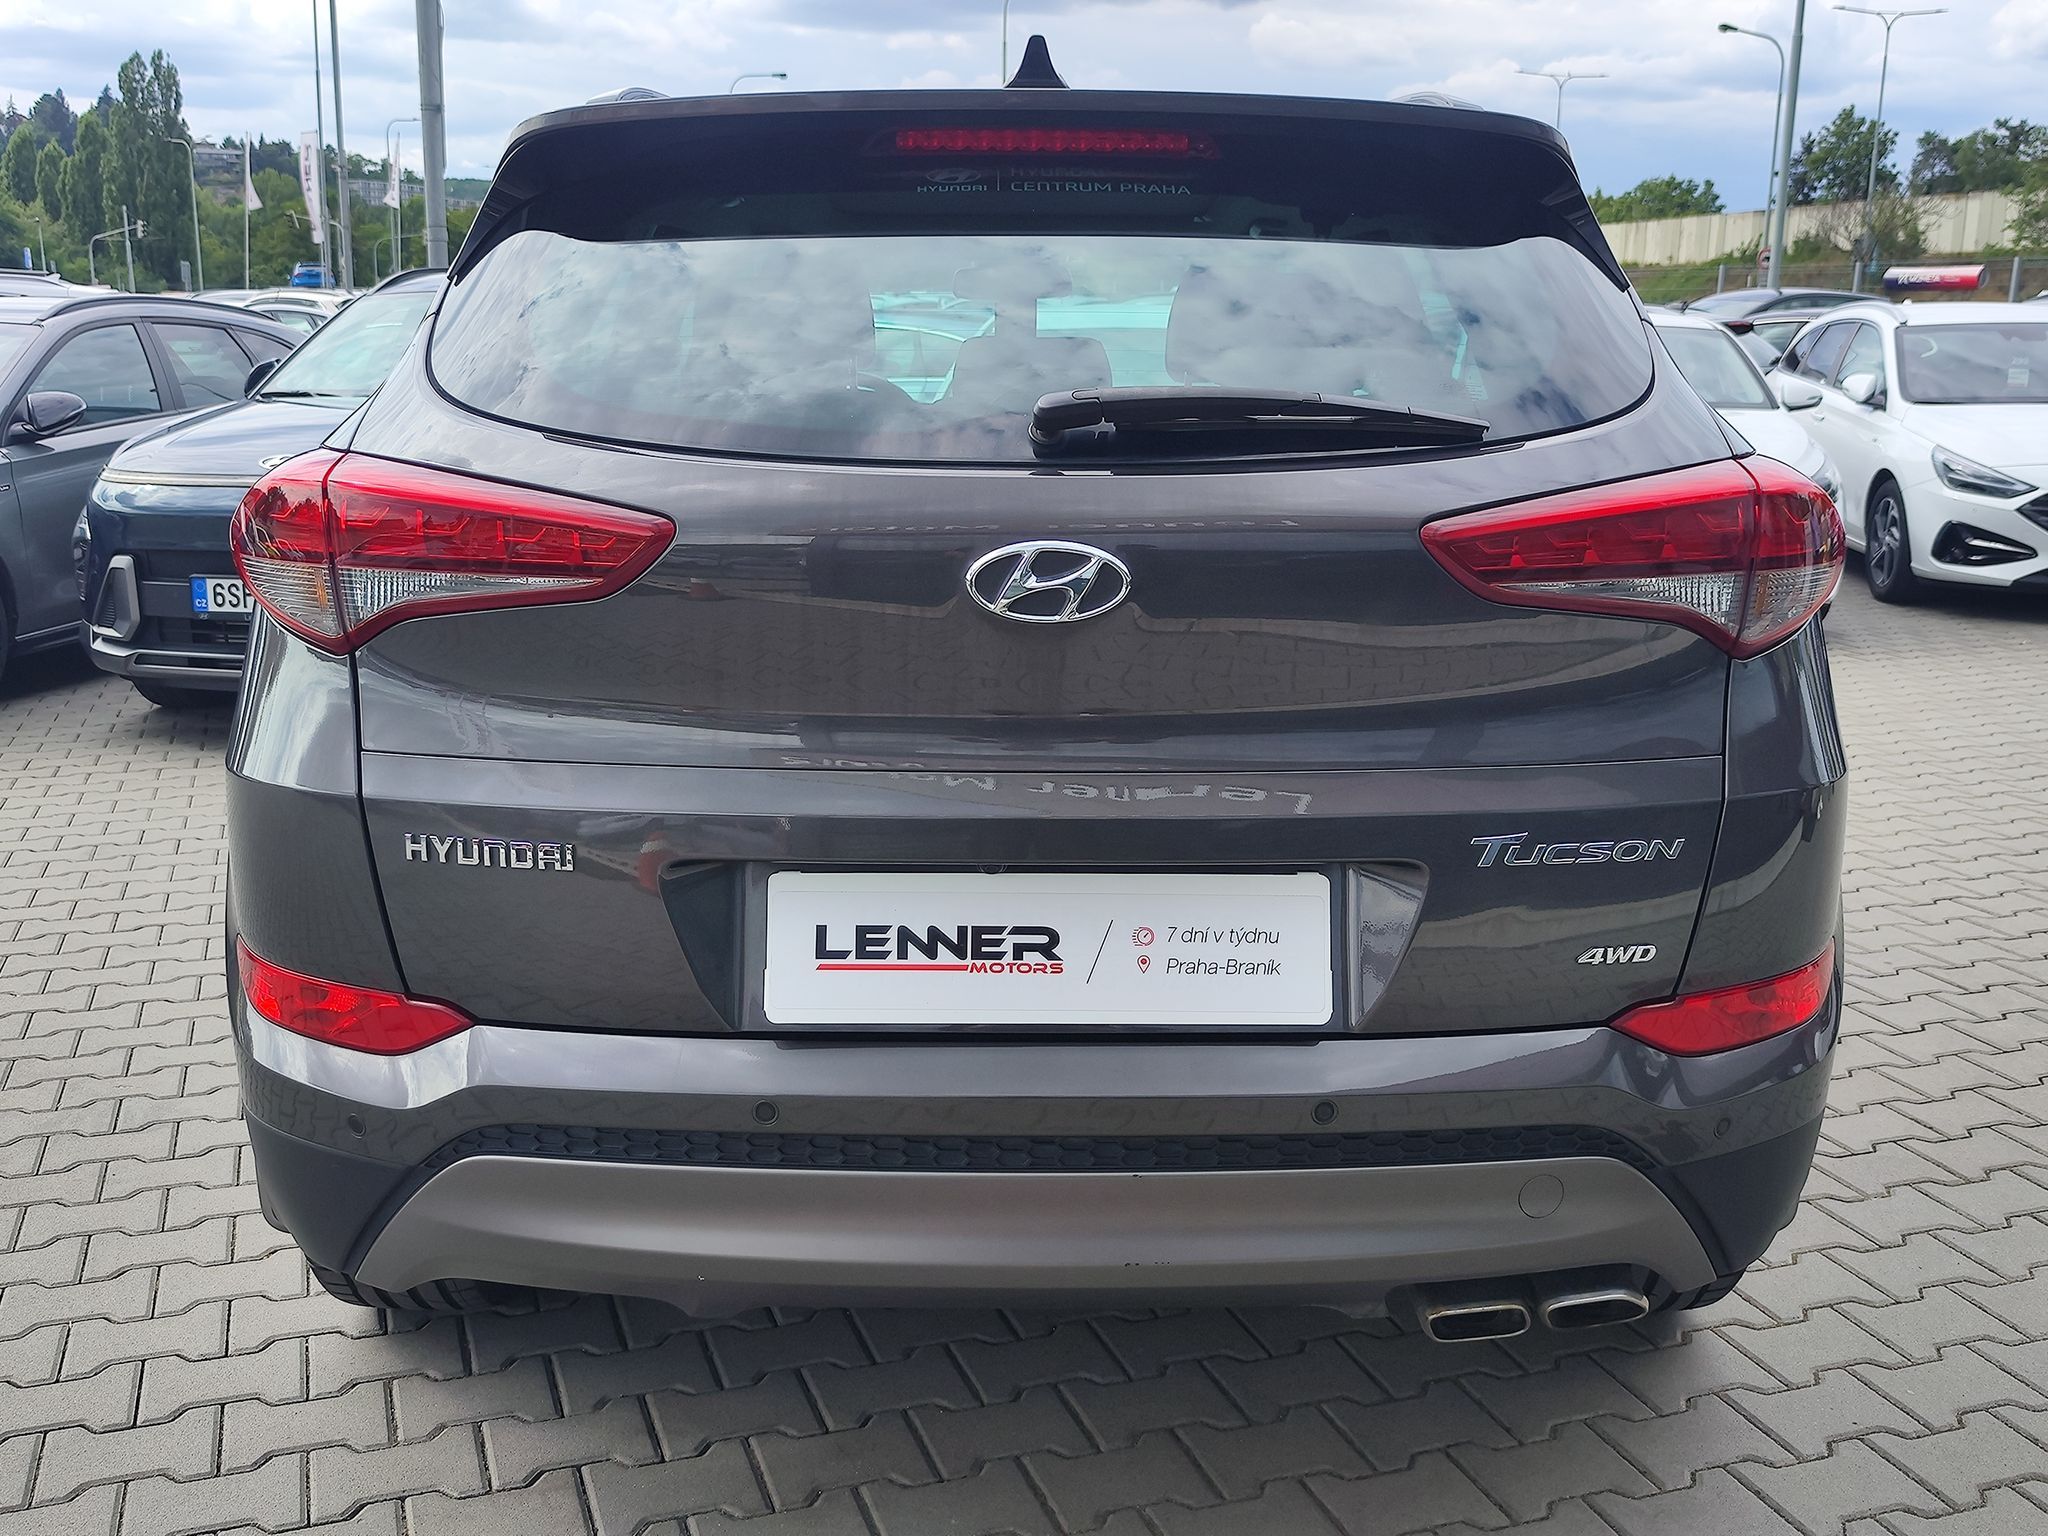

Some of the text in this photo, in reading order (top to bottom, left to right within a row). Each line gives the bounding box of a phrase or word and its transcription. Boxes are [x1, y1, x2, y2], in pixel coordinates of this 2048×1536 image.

[917, 185, 987, 194] HYUNDAI
[1010, 181, 1191, 195] CENTRUM PRAHA
[195, 598, 207, 608] CZ
[404, 832, 575, 871] HYUNDAI
[815, 925, 1064, 961] LENNER
[1167, 926, 1280, 948] 7 dní v týdnu
[1576, 944, 1657, 965] 4WD
[968, 962, 1064, 974] MOTORS
[1166, 958, 1281, 976] Praha-Braník
